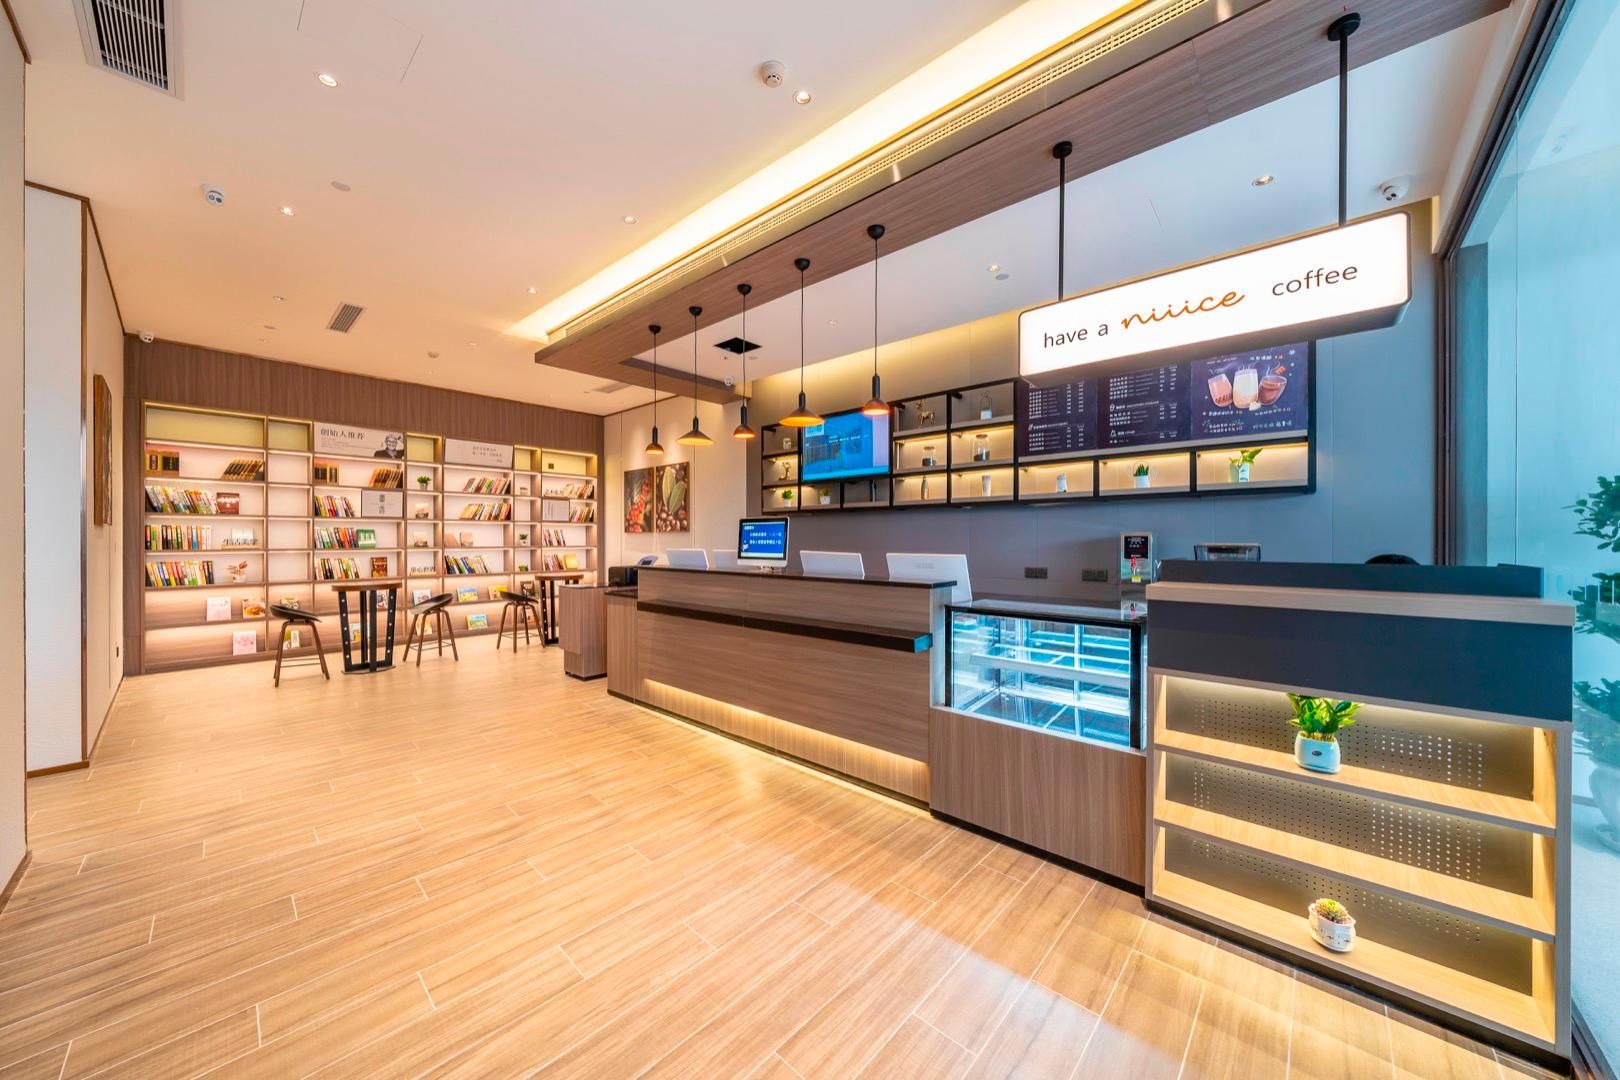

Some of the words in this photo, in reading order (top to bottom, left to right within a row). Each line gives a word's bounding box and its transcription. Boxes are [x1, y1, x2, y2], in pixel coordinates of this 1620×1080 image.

[1044, 325, 1088, 348] have
[1098, 322, 1109, 337] a
[1121, 291, 1245, 329] niiice
[1272, 264, 1358, 297] coffee
[320, 428, 365, 440] 创始人推荐
